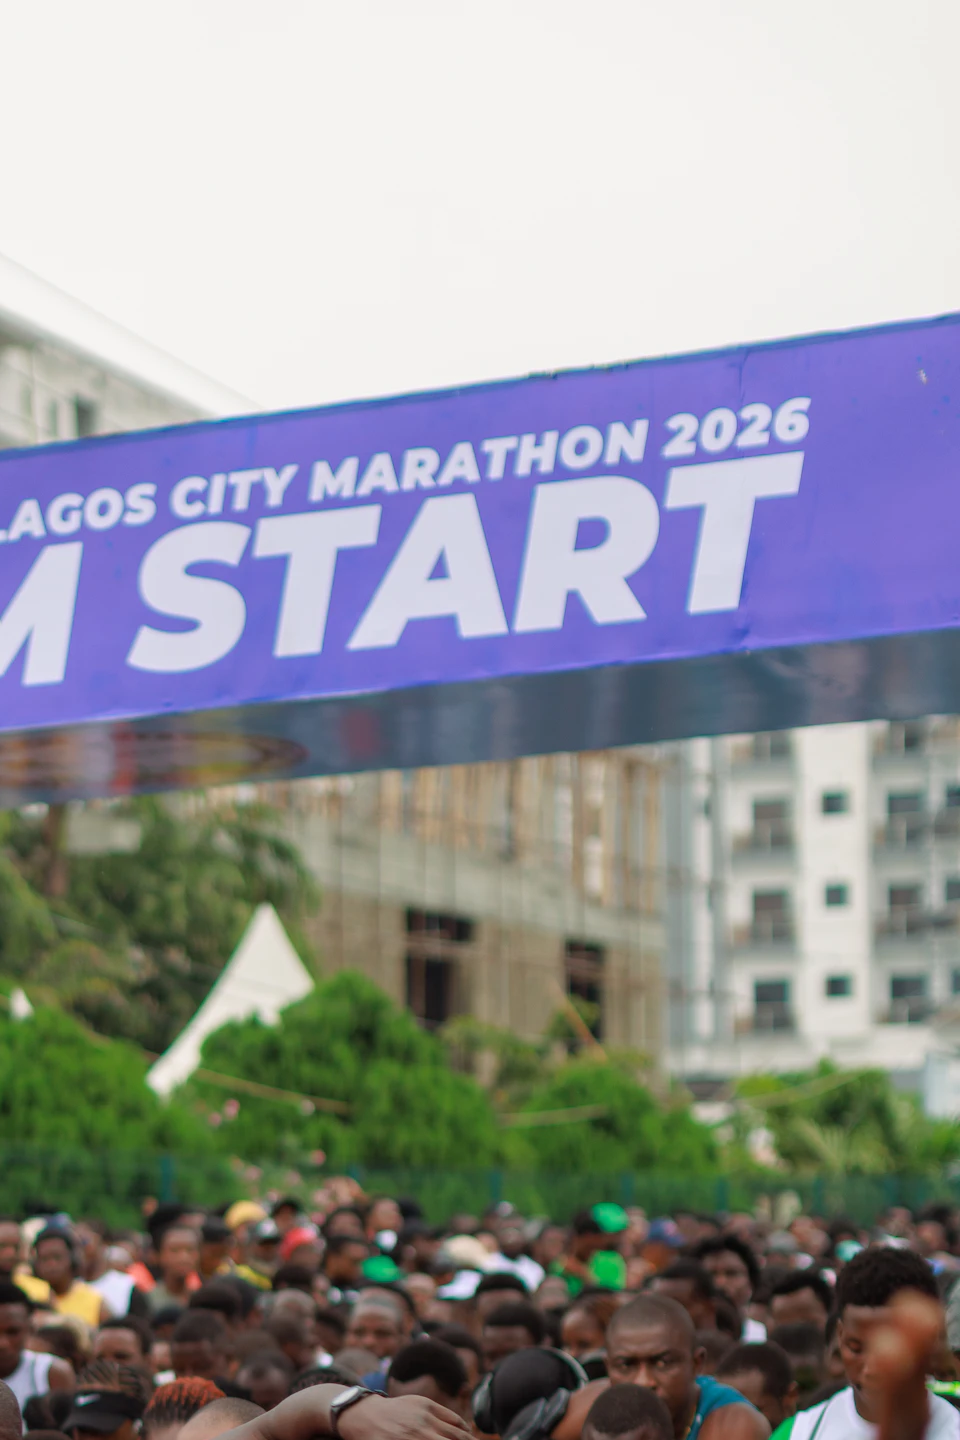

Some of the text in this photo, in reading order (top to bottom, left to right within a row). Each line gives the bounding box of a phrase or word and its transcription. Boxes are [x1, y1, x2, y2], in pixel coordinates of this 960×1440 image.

[170, 463, 299, 519] CITY
[308, 418, 650, 503] MARATHON
[662, 396, 812, 458] 2026
[126, 451, 806, 672] START
